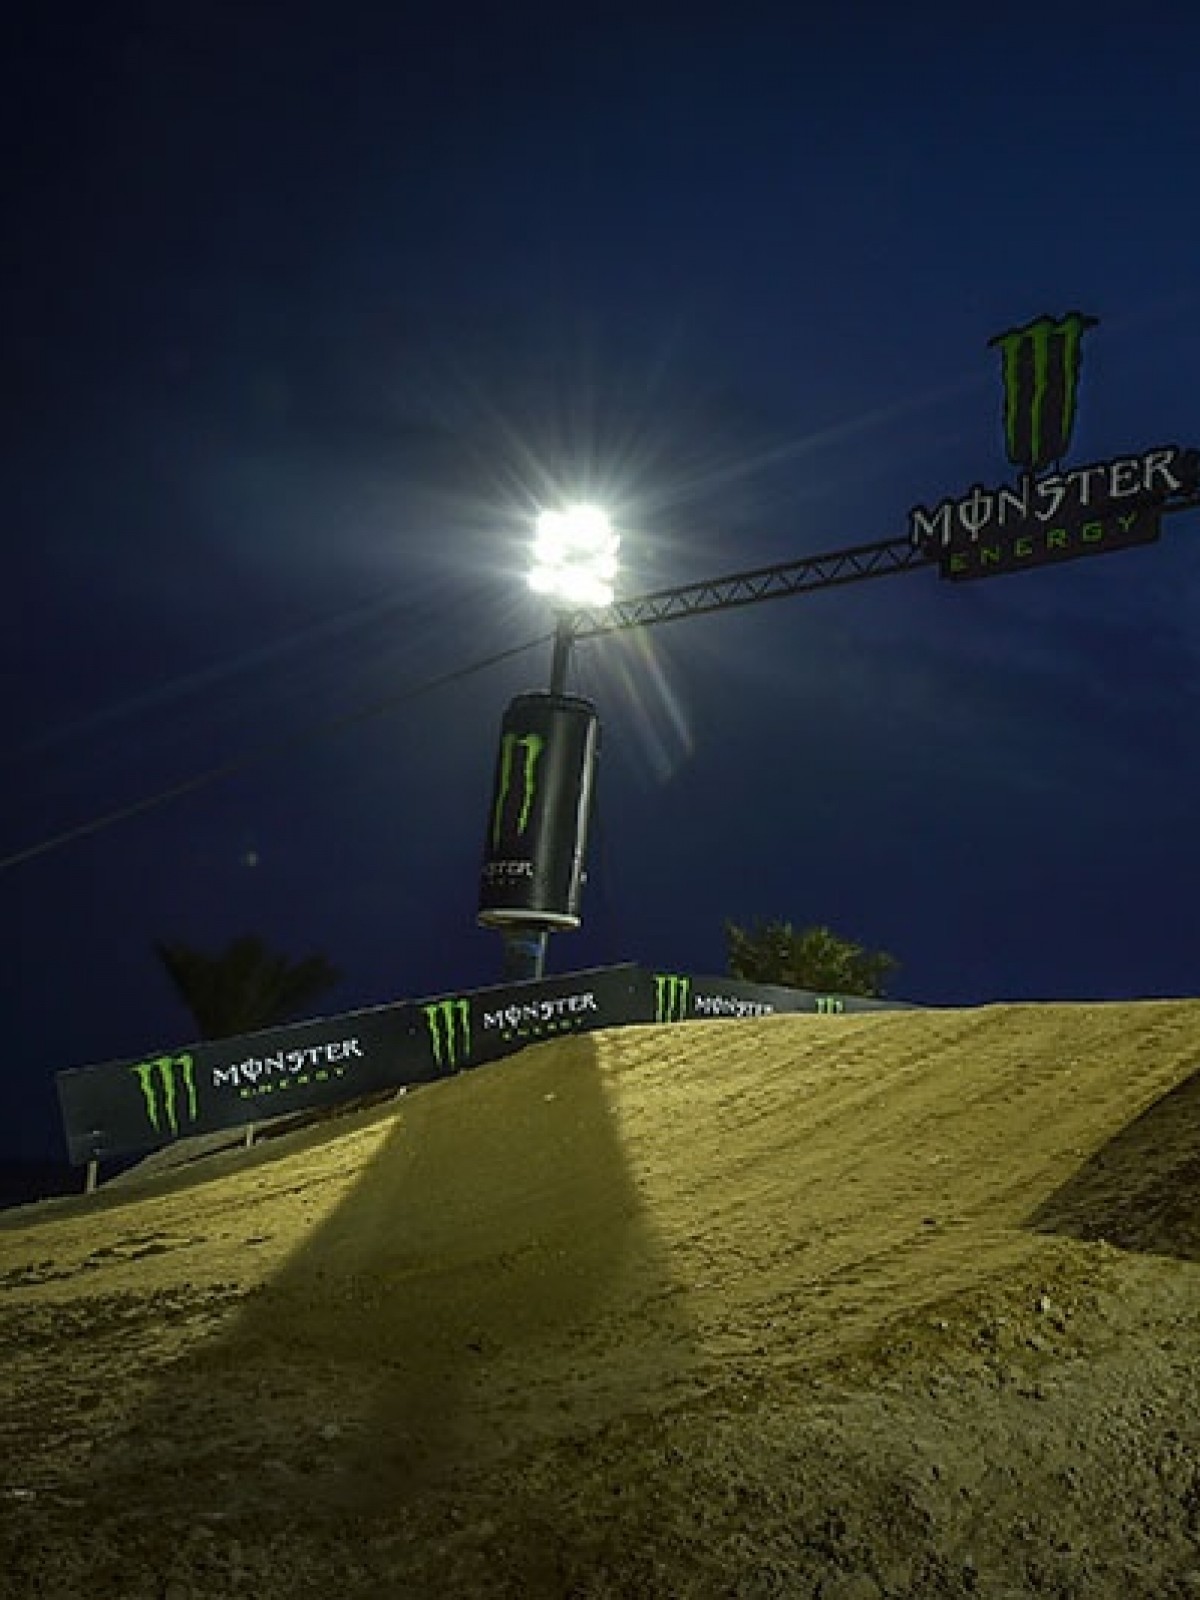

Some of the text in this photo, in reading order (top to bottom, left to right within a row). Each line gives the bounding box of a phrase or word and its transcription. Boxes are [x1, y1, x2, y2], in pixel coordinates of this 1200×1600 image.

[911, 449, 1182, 546] MONSTER
[949, 511, 1138, 573] ENERGY
[212, 1037, 365, 1088] MONSTER
